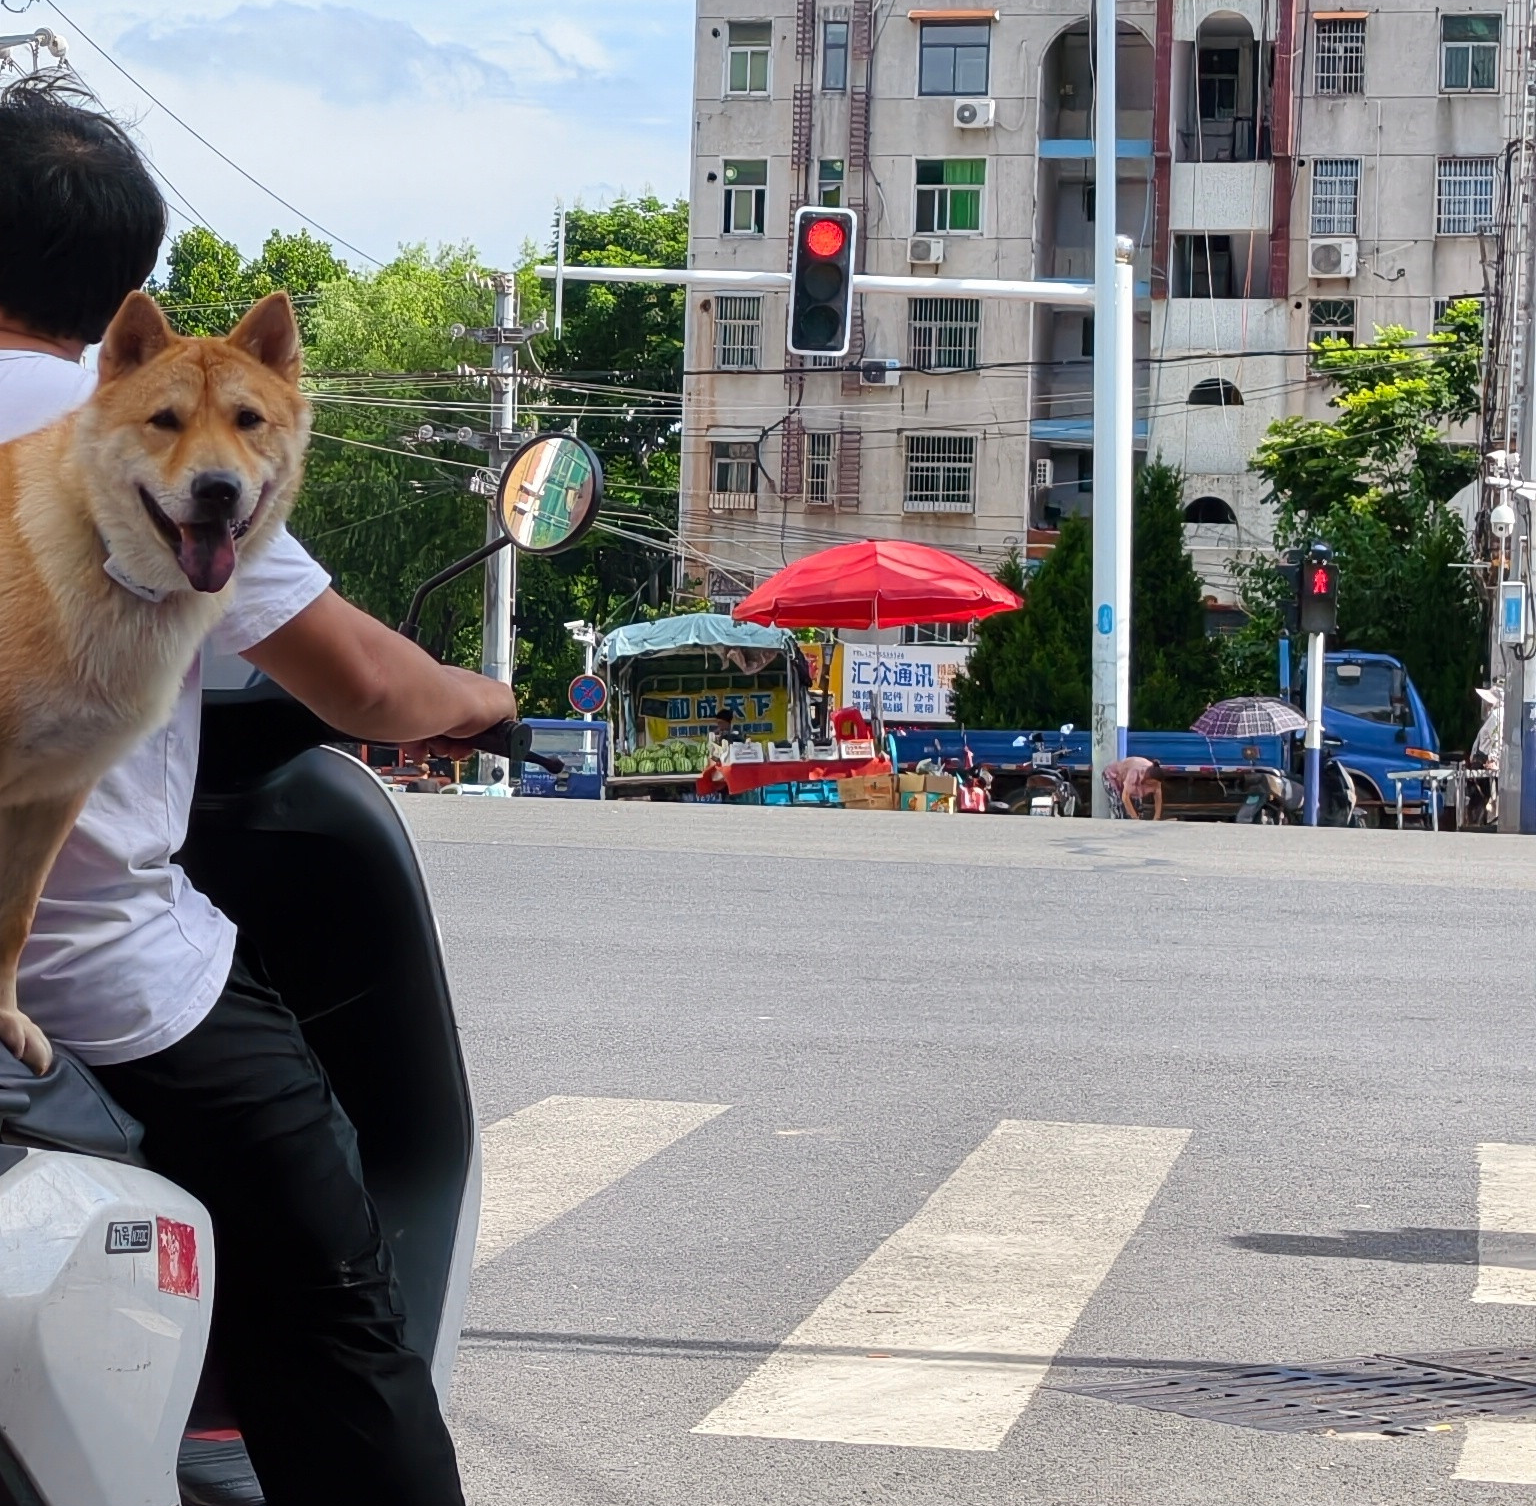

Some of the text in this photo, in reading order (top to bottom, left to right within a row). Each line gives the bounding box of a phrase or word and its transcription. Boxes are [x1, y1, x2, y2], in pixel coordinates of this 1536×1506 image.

[851, 660, 934, 688] 汇众通讯
[882, 692, 904, 702] 配件
[913, 693, 935, 703] 办卡
